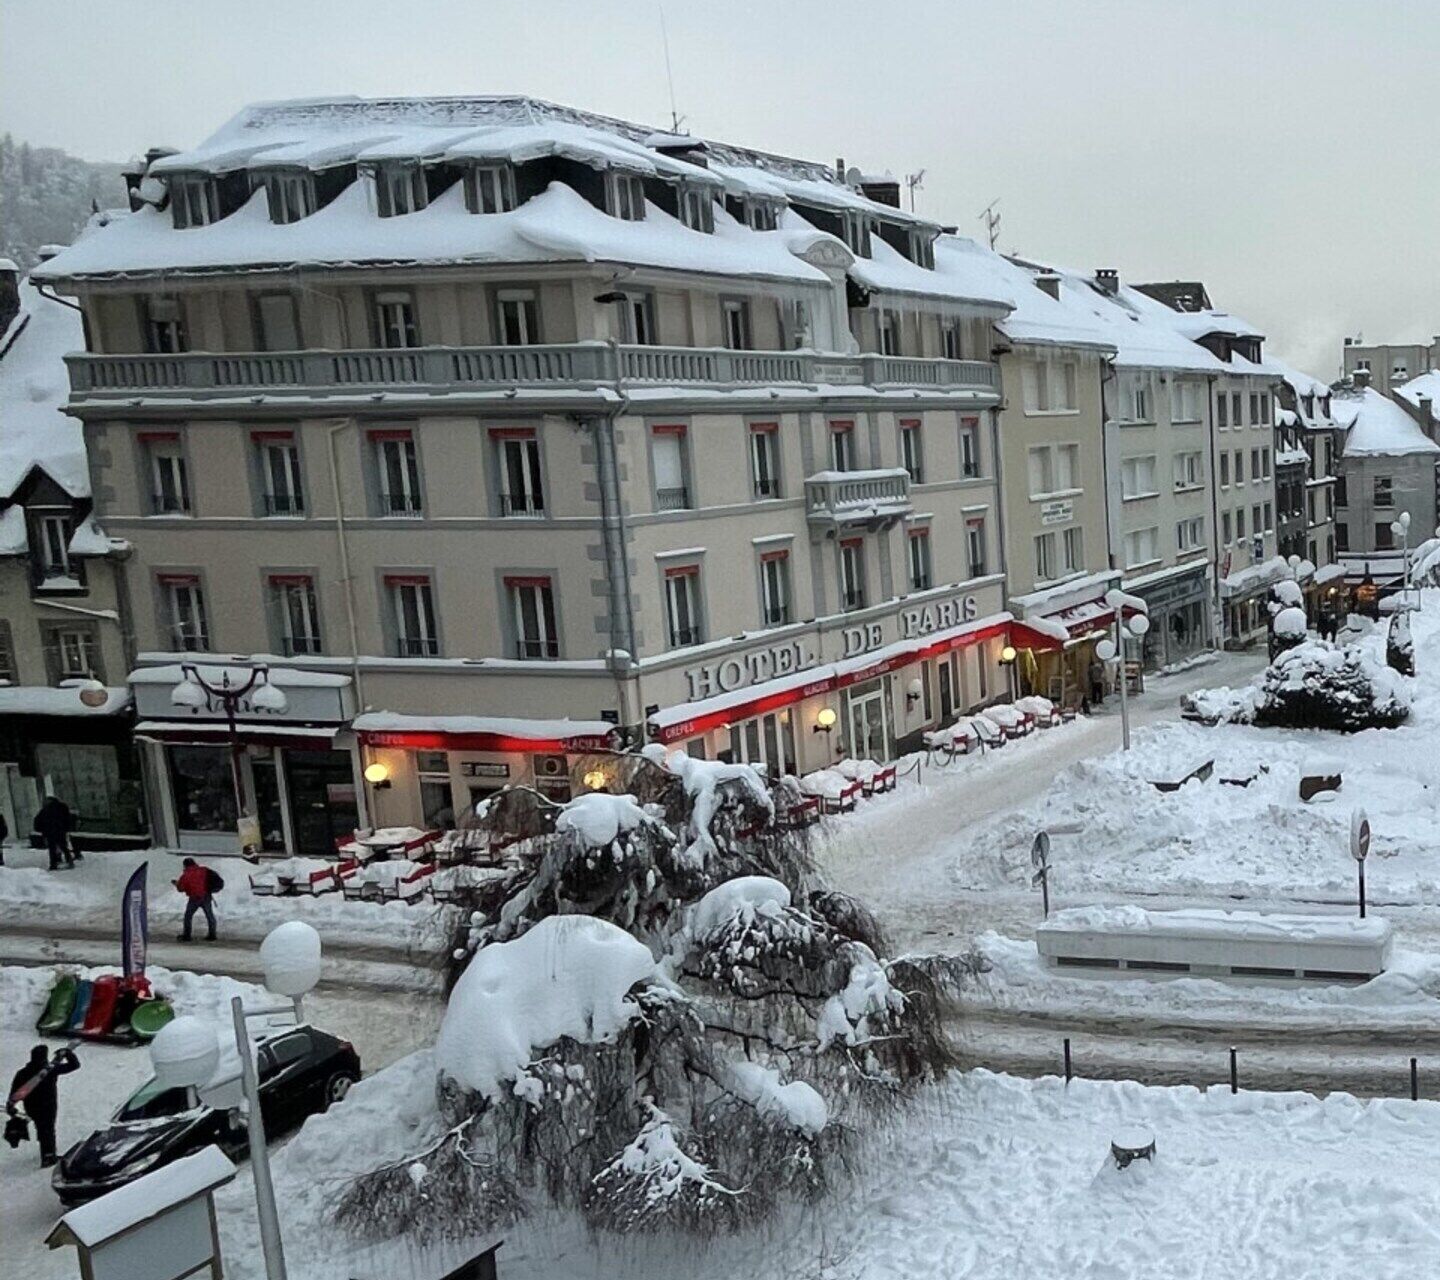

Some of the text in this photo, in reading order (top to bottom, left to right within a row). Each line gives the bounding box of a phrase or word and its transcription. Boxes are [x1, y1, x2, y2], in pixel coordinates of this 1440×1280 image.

[685, 641, 821, 702] HOTEL
[842, 624, 883, 658] DE
[901, 595, 978, 639] PARIS
